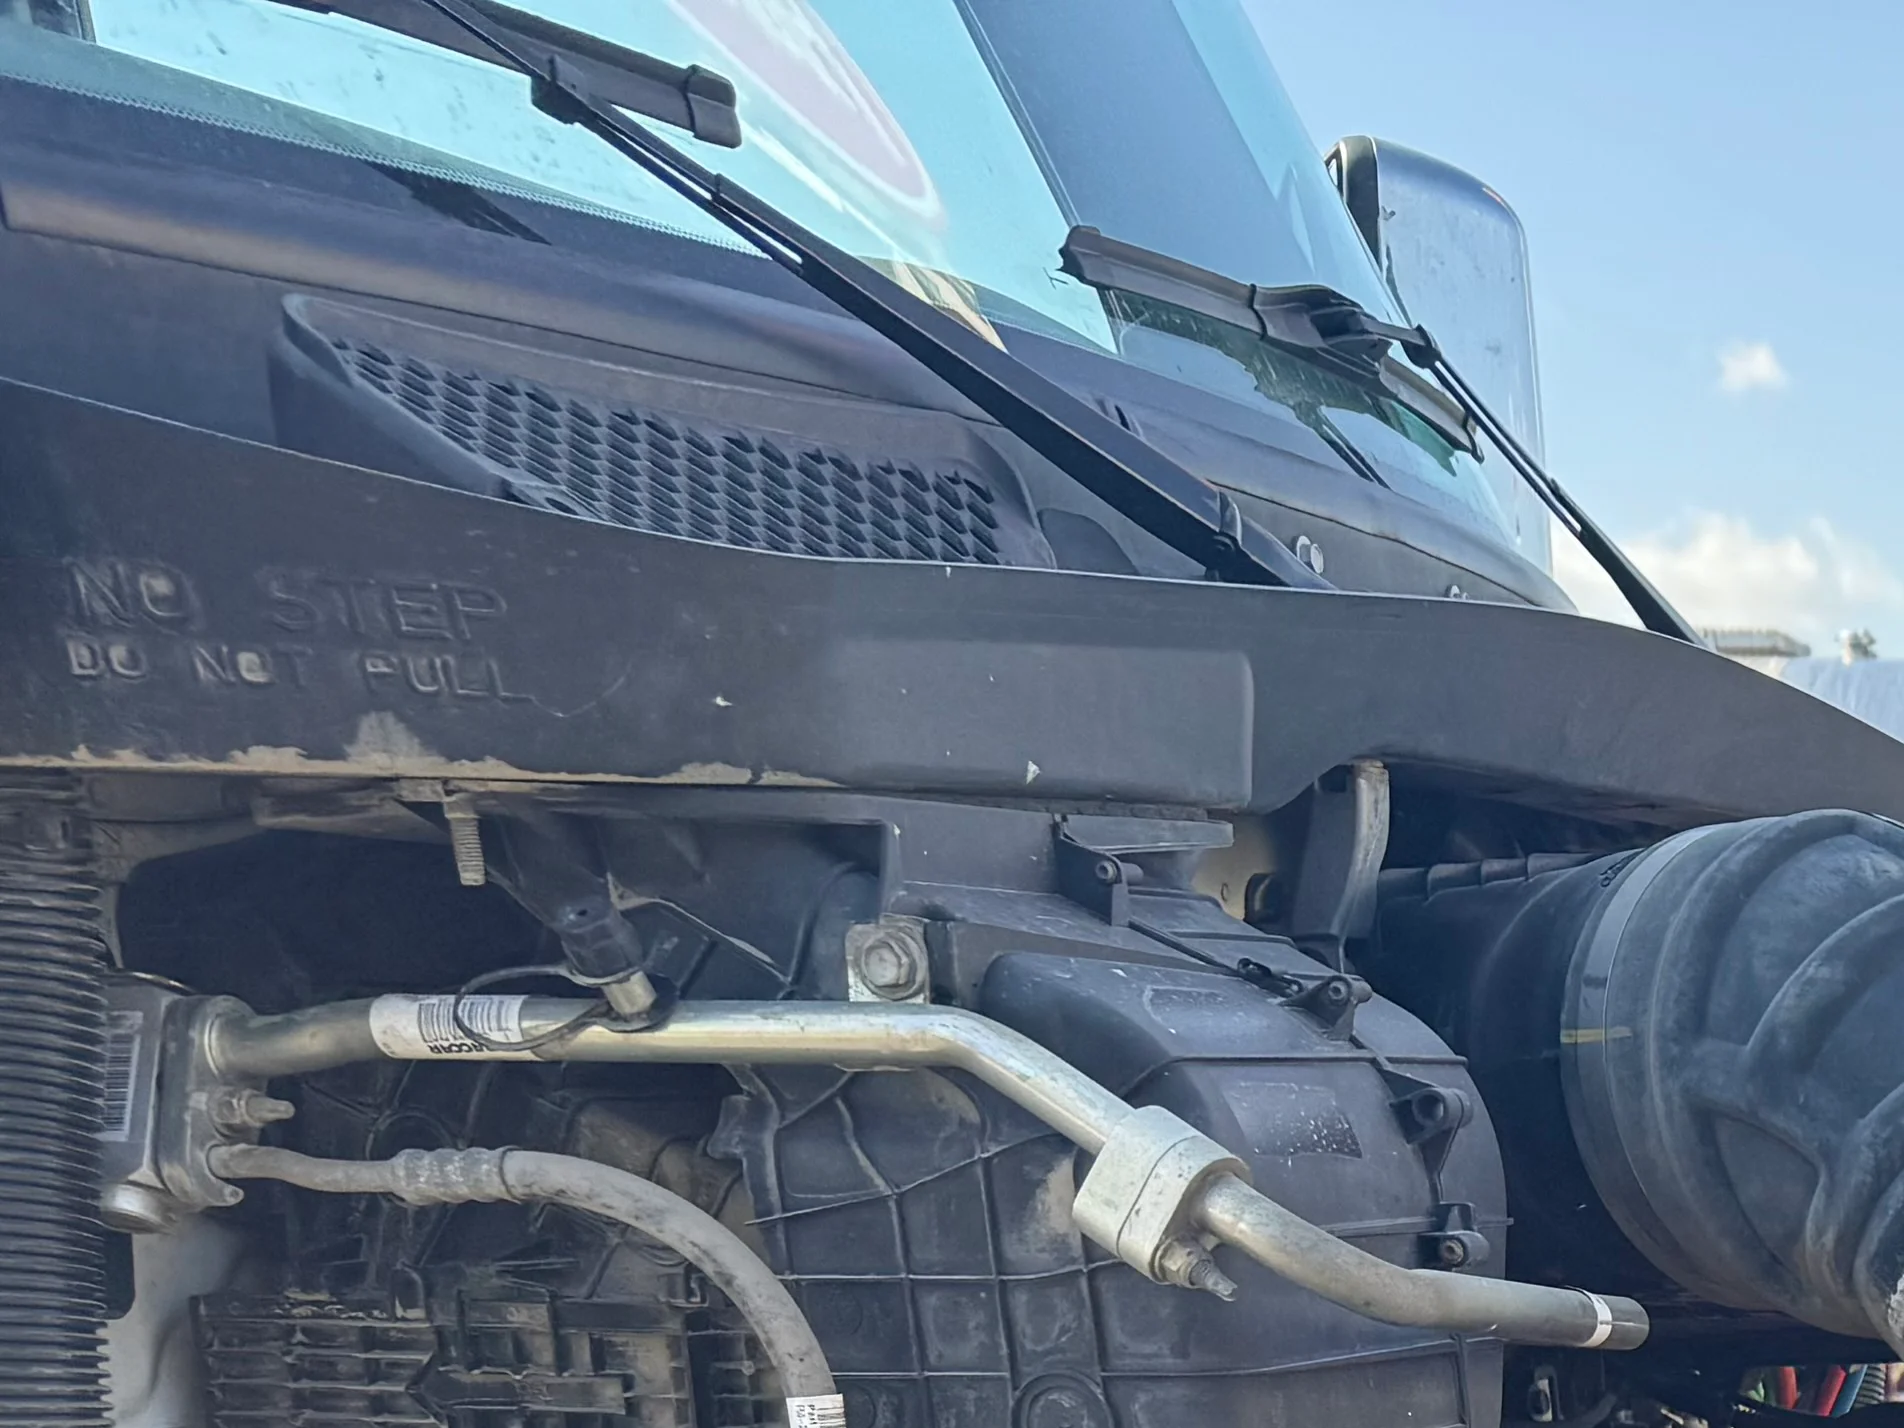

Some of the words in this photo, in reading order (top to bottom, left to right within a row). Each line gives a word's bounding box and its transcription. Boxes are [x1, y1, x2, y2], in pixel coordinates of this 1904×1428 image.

[66, 558, 193, 633] NO
[262, 567, 506, 640] STEP
[66, 640, 147, 682] DO
[193, 643, 315, 687] NOT
[361, 651, 533, 702] PULL
[427, 1042, 488, 1055] ACCAR
